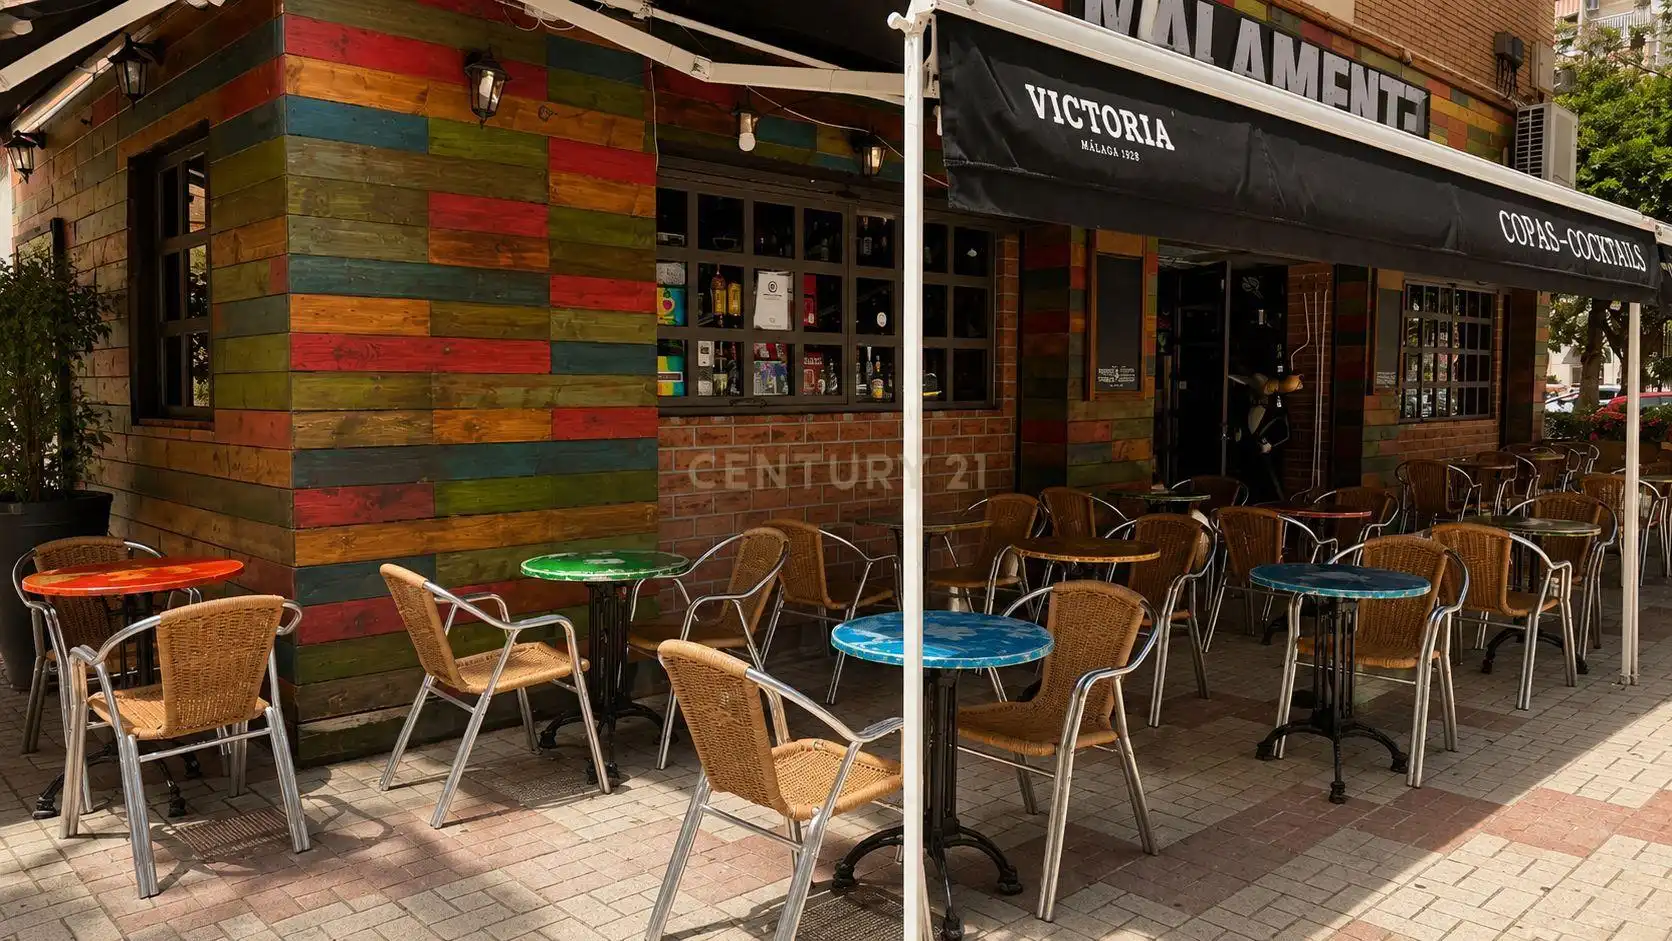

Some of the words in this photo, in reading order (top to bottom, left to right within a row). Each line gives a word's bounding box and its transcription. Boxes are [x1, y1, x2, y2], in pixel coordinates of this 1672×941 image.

[1025, 83, 1175, 151] VICTORIA
[1081, 139, 1119, 157] MÁLAGA
[1121, 149, 1140, 162] 1928
[1499, 209, 1647, 273] COPAS-COCKTAILS
